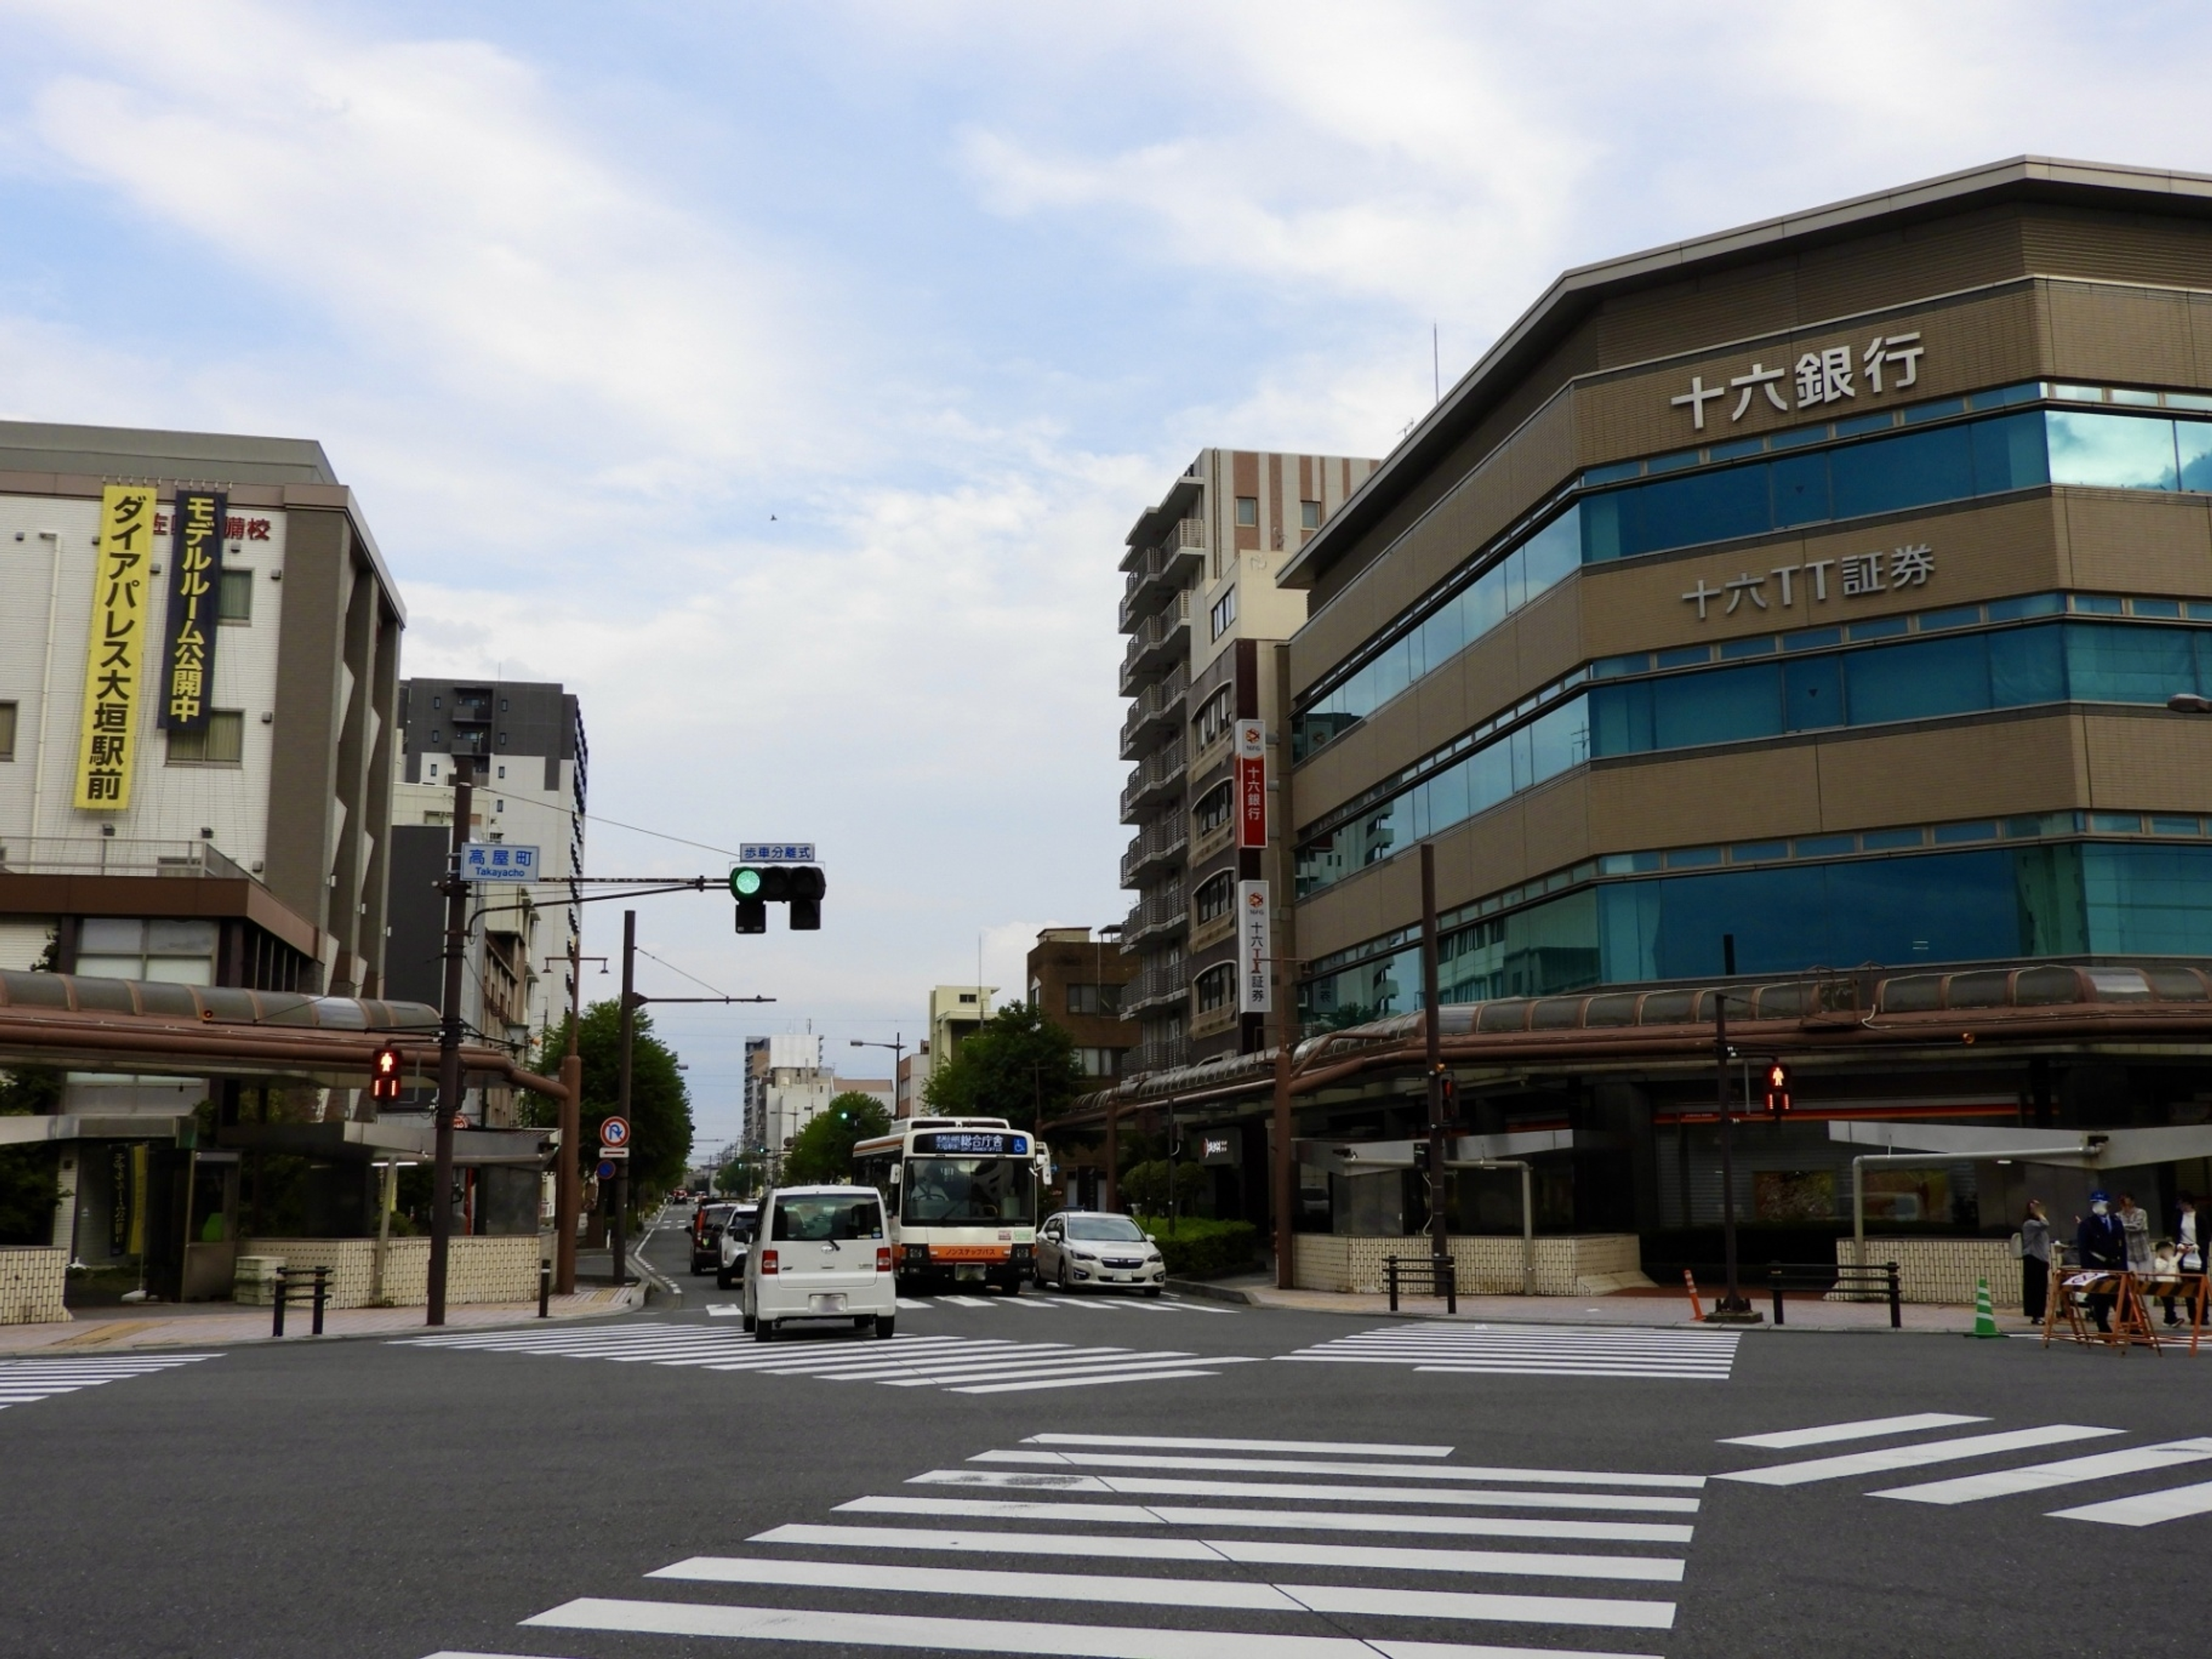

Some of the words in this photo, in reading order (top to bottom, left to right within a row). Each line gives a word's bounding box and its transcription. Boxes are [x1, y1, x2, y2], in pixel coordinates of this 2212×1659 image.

[1671, 332, 1925, 429] 十六銀行
[1681, 543, 1935, 619] 十六TT証券
[170, 497, 215, 723] モデルルーム公開中
[88, 495, 146, 800] ダイアパレス大垣駅前
[1248, 767, 1260, 820] 十六銀行
[469, 849, 532, 866] 高屋町
[476, 867, 525, 877] Takayacho
[745, 846, 810, 858] 歩車分離式
[961, 1135, 1003, 1147] 総合庁舎
